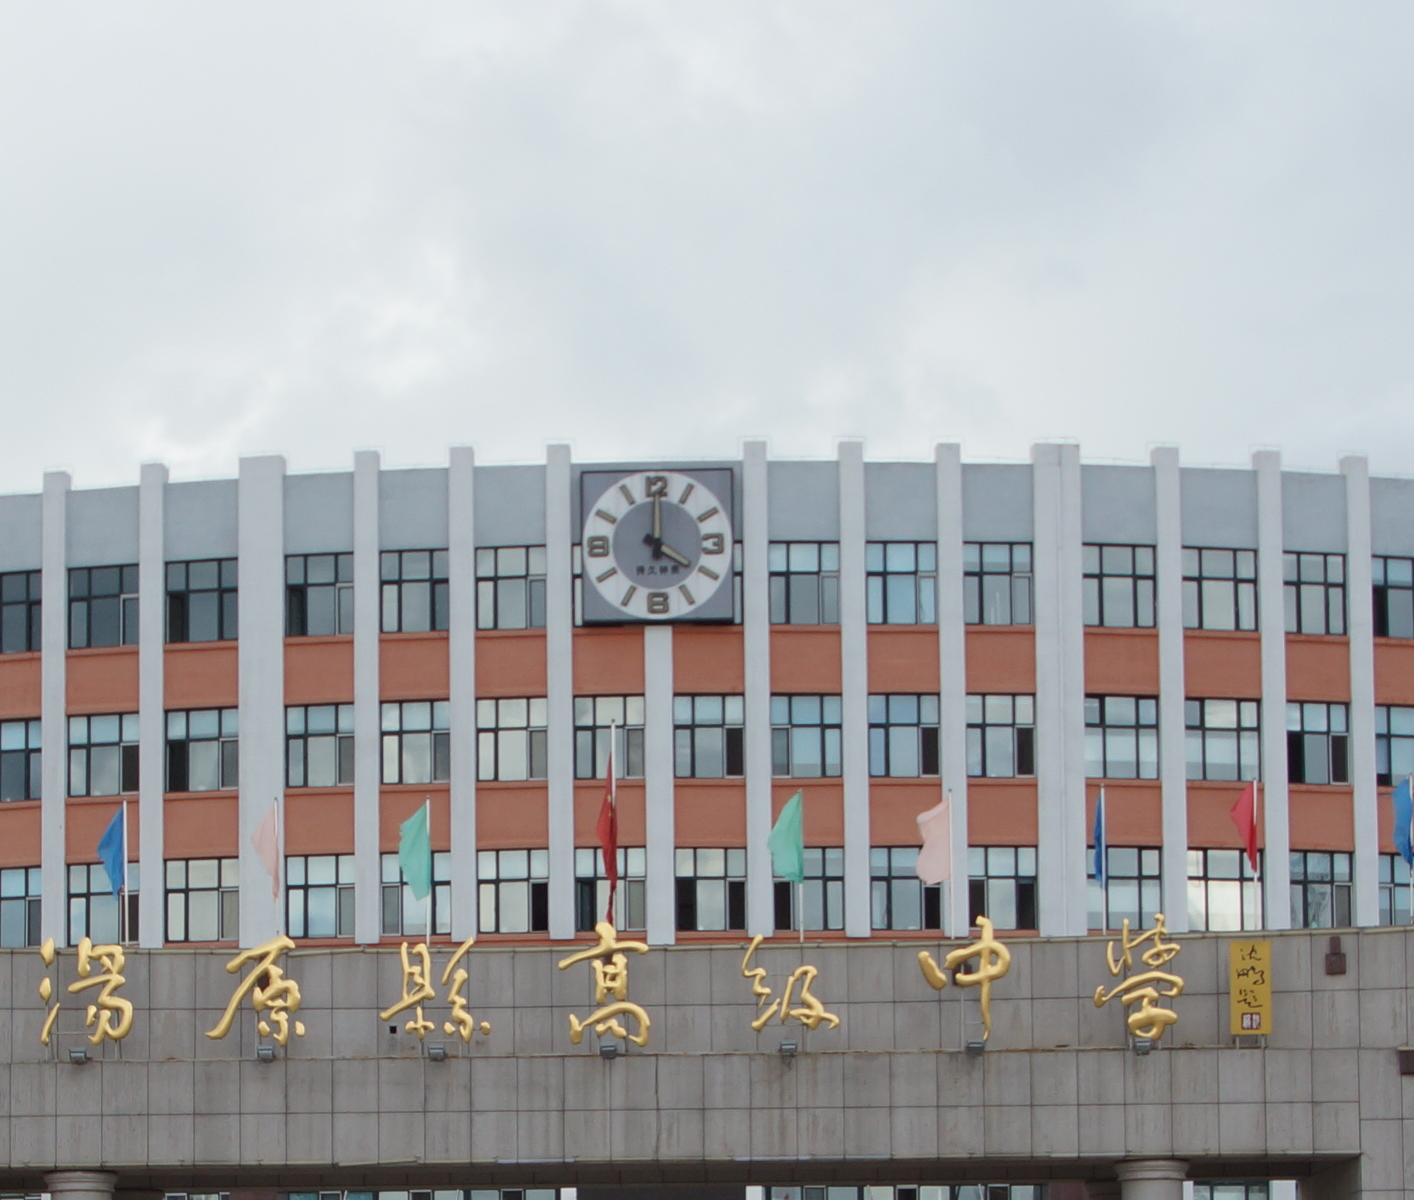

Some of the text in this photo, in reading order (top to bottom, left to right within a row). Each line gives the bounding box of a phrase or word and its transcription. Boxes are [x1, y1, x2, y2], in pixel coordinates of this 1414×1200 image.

[645, 476, 668, 498] 12
[588, 535, 609, 557] 9
[701, 533, 725, 555] 3
[646, 591, 670, 614] 6
